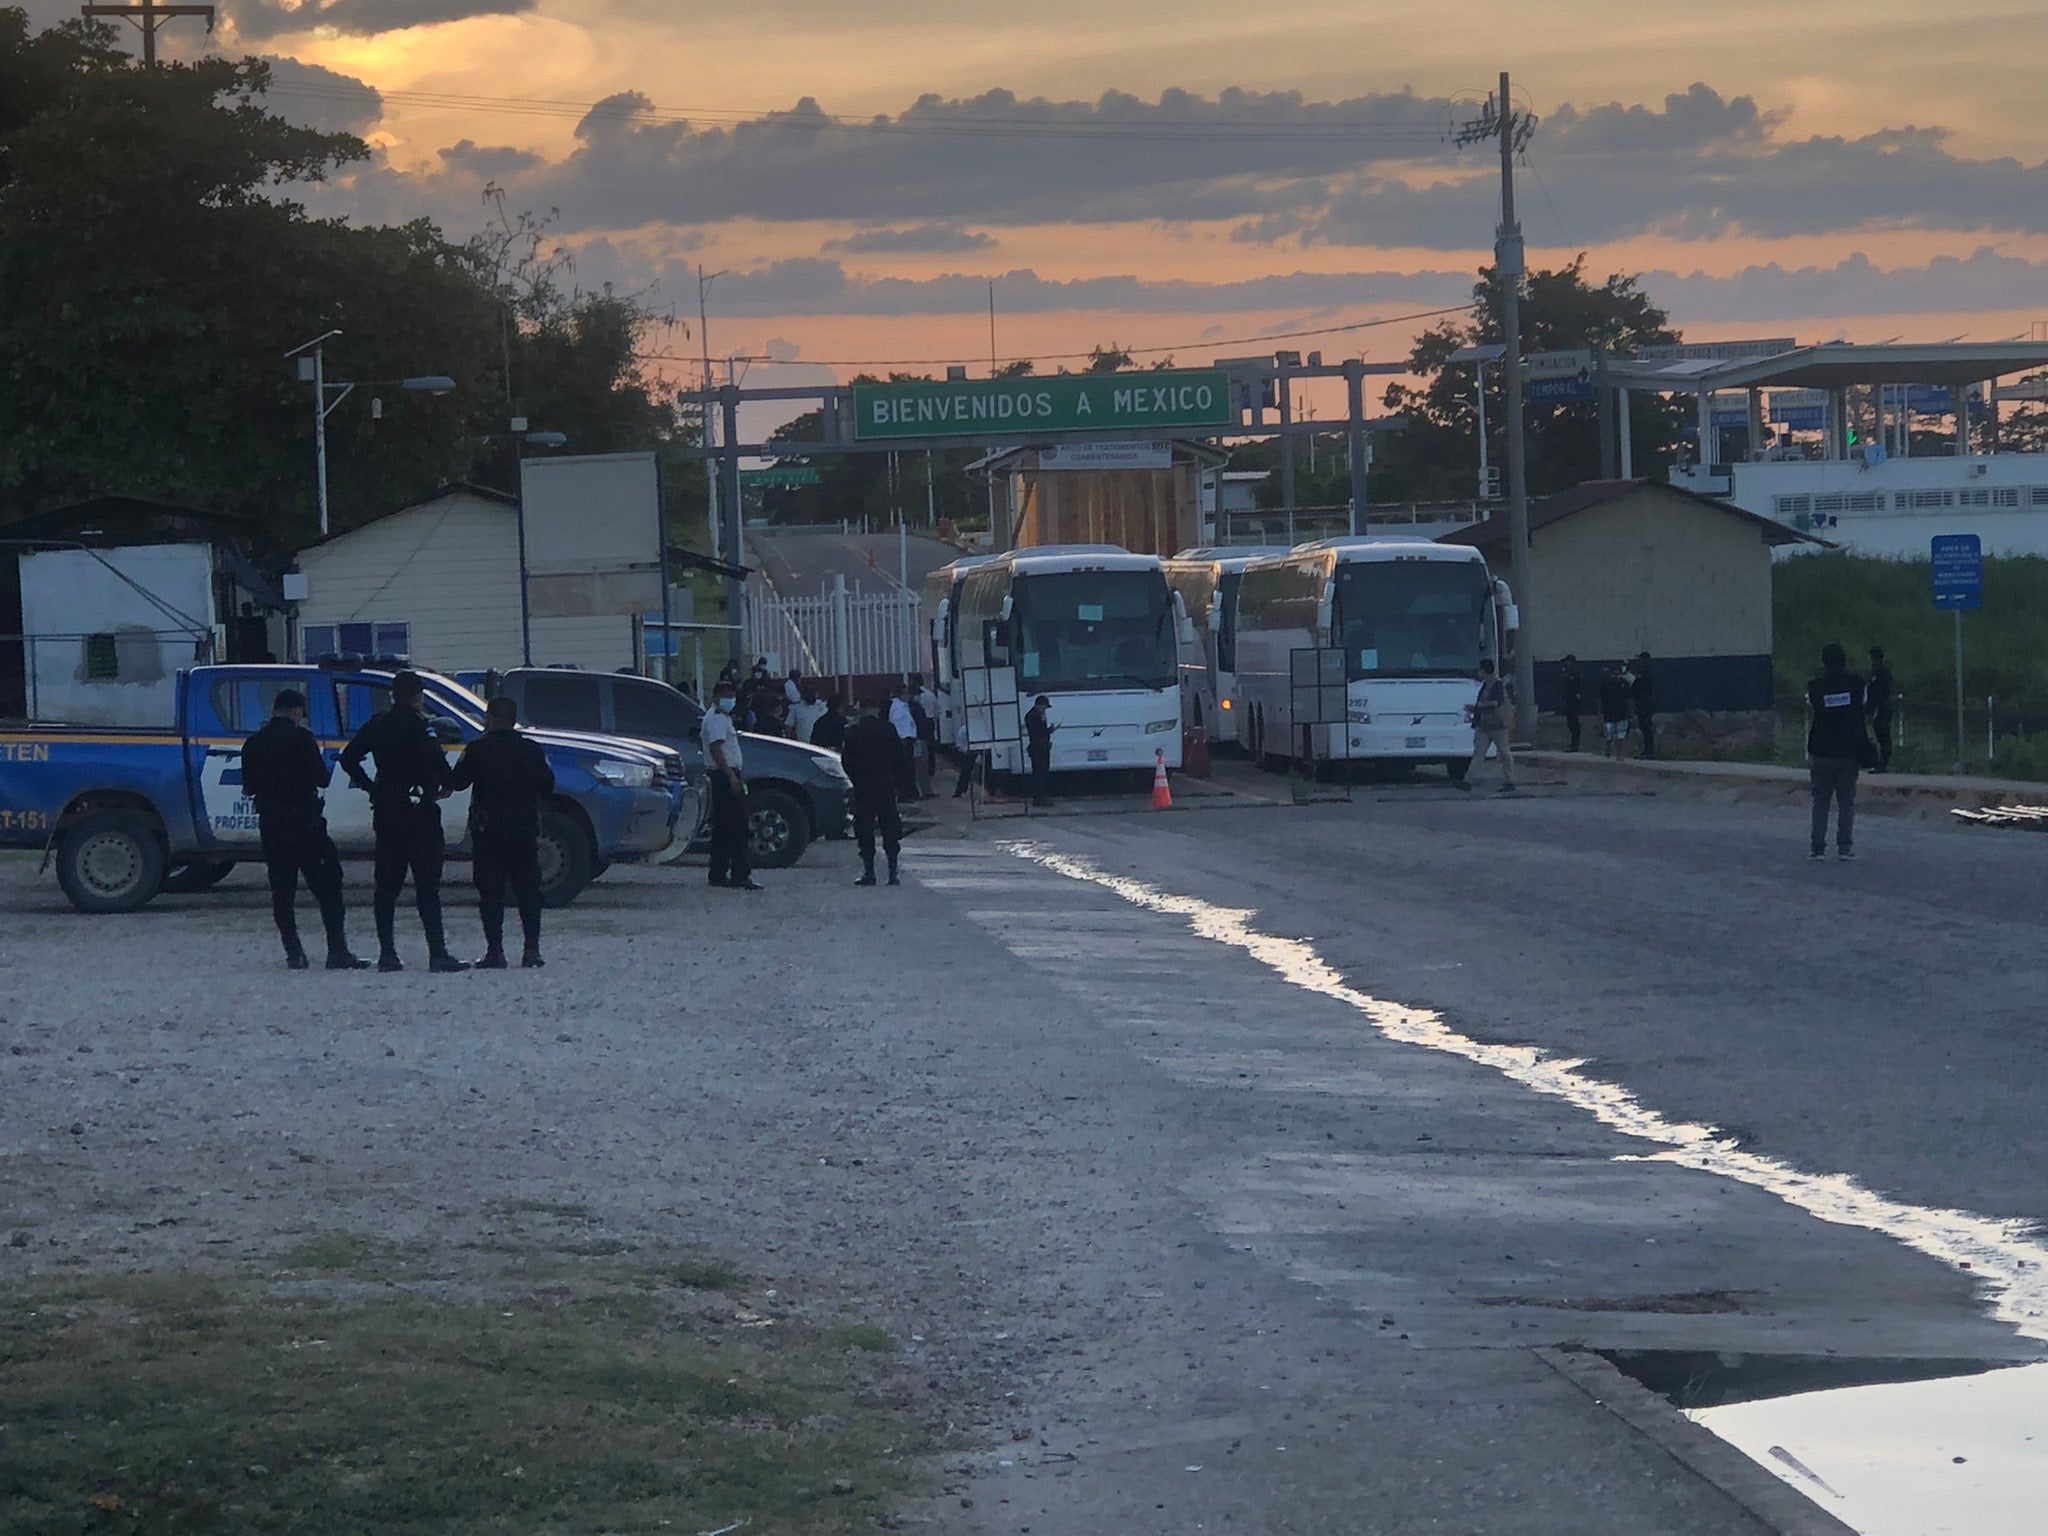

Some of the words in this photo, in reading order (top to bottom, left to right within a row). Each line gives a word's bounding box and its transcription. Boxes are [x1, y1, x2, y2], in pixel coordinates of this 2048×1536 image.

[1531, 381, 1579, 397] TEMPORAL
[873, 393, 1052, 424] BIENVENIDOS
[1076, 391, 1093, 415] A
[1113, 385, 1213, 413] MEXICO
[0, 744, 49, 761] TEN
[215, 815, 258, 829] PROFES
